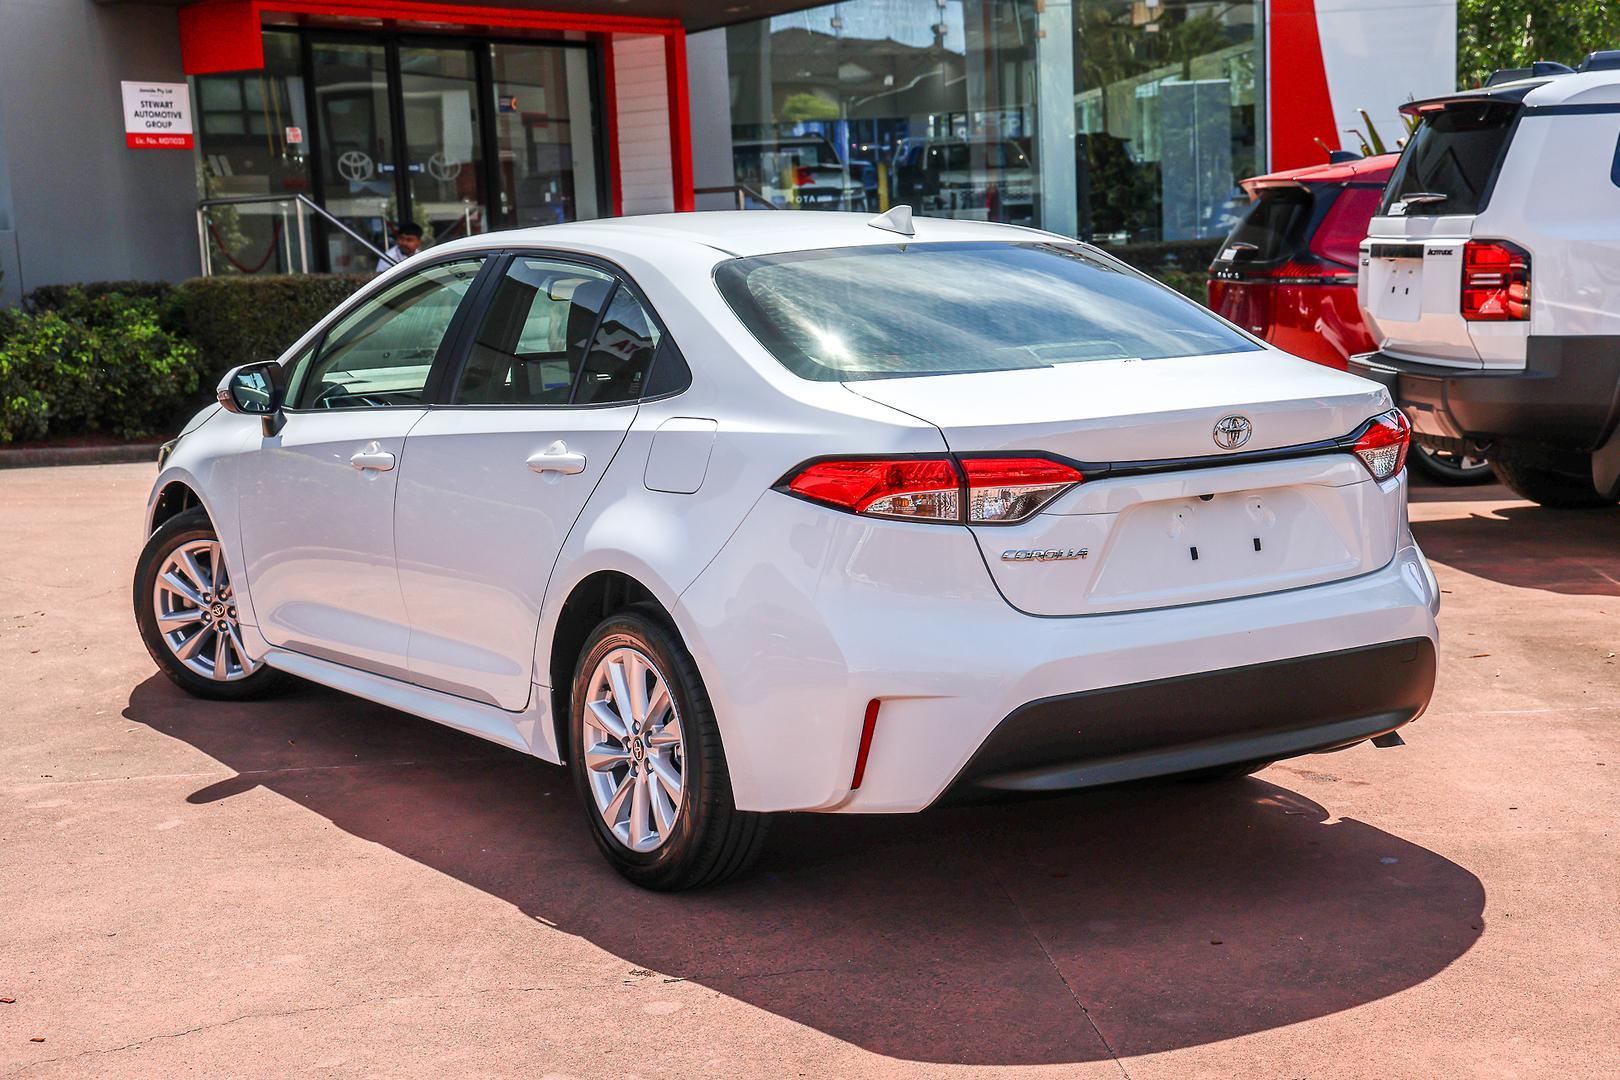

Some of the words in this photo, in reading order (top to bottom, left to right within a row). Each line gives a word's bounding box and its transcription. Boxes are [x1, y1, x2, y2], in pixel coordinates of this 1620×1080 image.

[140, 100, 173, 108] STEWART
[134, 110, 182, 119] AUTOMOTIVE
[145, 120, 173, 128] GROUP
[1002, 548, 1088, 560] COROLLA
